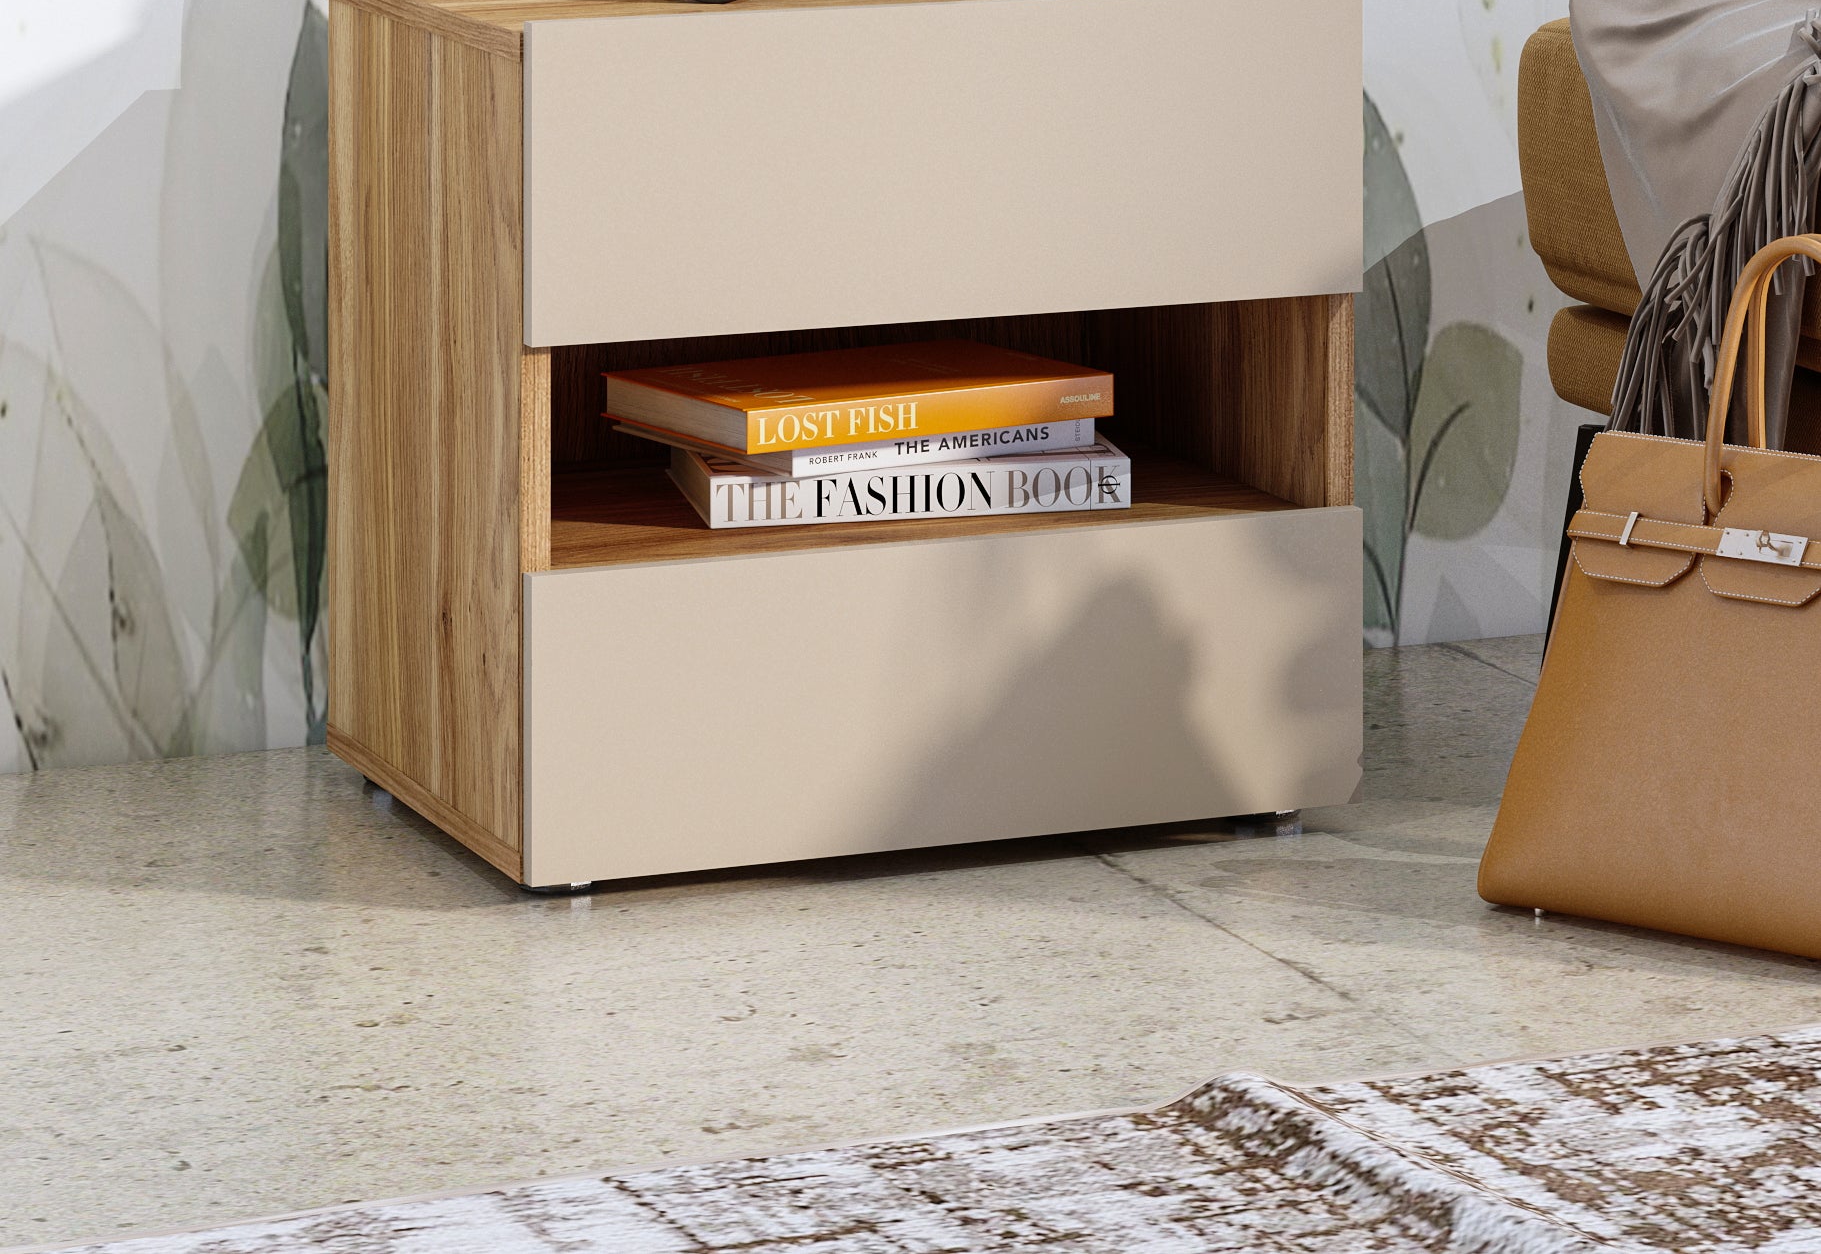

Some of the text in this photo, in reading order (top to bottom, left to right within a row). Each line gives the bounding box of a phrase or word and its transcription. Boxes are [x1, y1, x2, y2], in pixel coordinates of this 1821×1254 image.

[1060, 392, 1101, 404] ASSOULINE
[756, 401, 919, 446] LOST FISH
[894, 426, 1050, 456] THE AMERICANS
[809, 450, 878, 465] ROBERT FRANK
[716, 464, 1124, 523] THE FASHION BOOK
